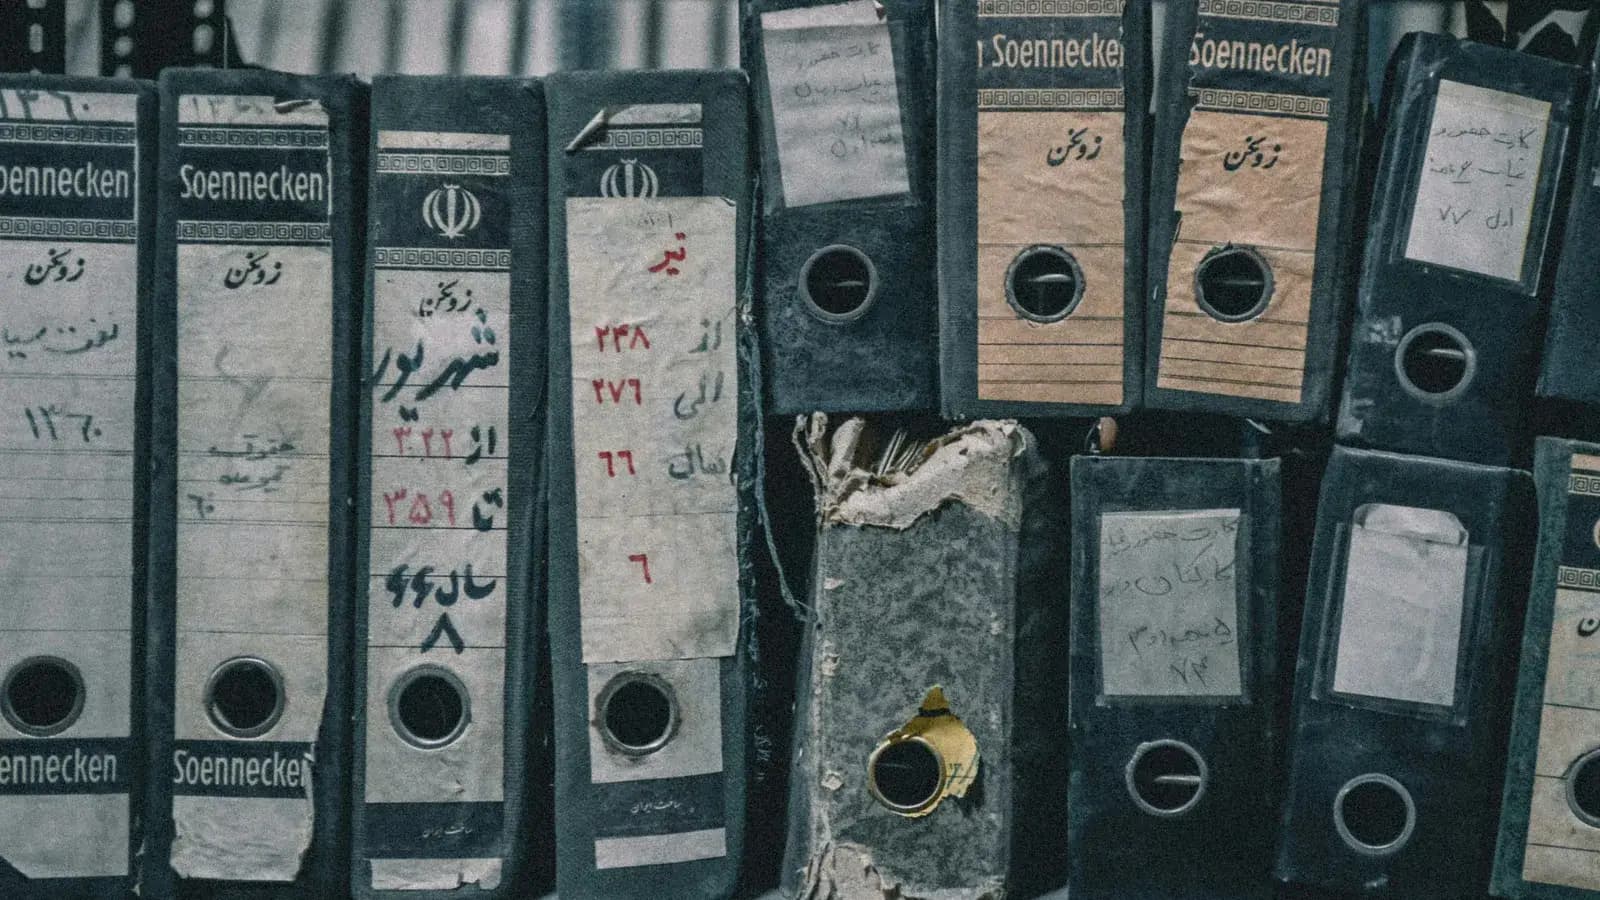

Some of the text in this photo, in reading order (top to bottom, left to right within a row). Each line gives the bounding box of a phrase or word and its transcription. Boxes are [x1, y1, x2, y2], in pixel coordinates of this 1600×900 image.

[1188, 32, 1332, 77] Soennecken
[1046, 128, 1103, 167] زونکن
[1223, 137, 1281, 171] زونکن
[180, 164, 323, 201] Soennecken
[24, 248, 85, 286] زونکن
[224, 252, 283, 289] زونکن
[648, 232, 686, 276] تیر
[383, 488, 456, 526] ۳۵۹
[435, 563, 497, 607] سال
[420, 612, 465, 655] ۸
